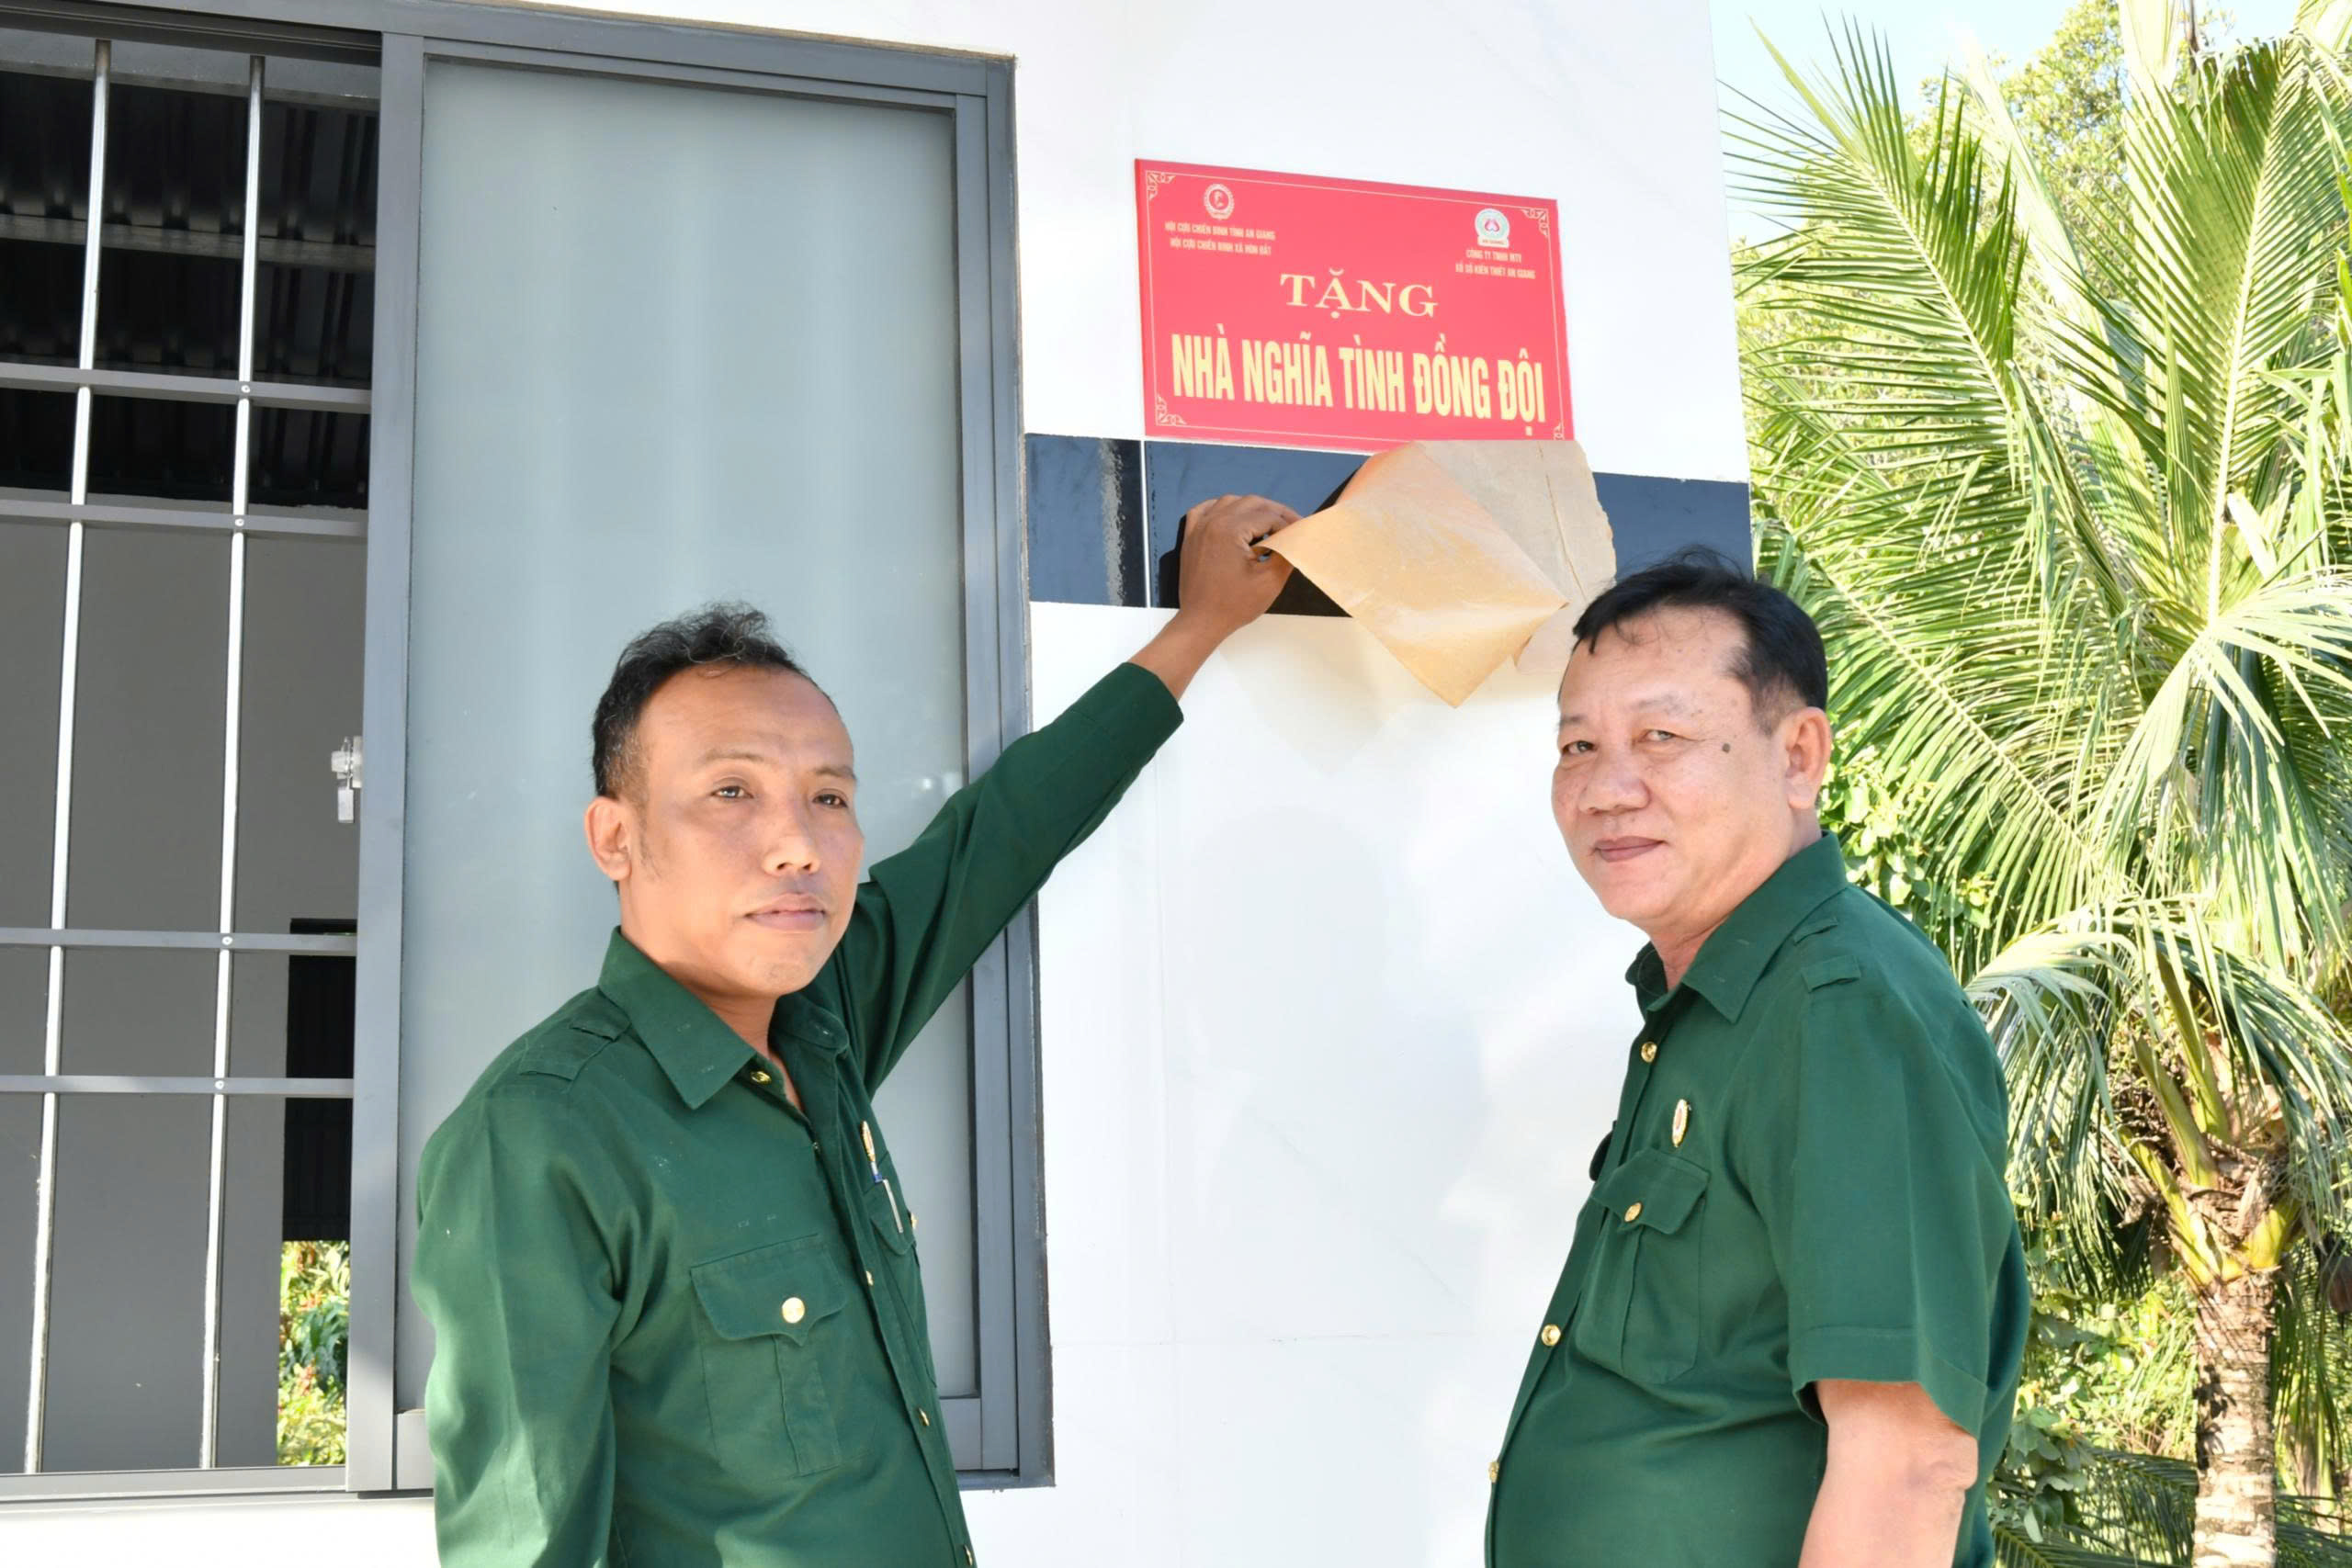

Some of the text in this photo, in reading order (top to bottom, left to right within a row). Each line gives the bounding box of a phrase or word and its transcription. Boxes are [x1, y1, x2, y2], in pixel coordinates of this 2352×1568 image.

[1245, 228, 1255, 238] AN
[1256, 230, 1276, 241] GIANG
[1280, 268, 1438, 319] TẶNG
[1171, 323, 1546, 436] NHÀ NGHĨA TÌNH ĐỒNG ĐỘI
